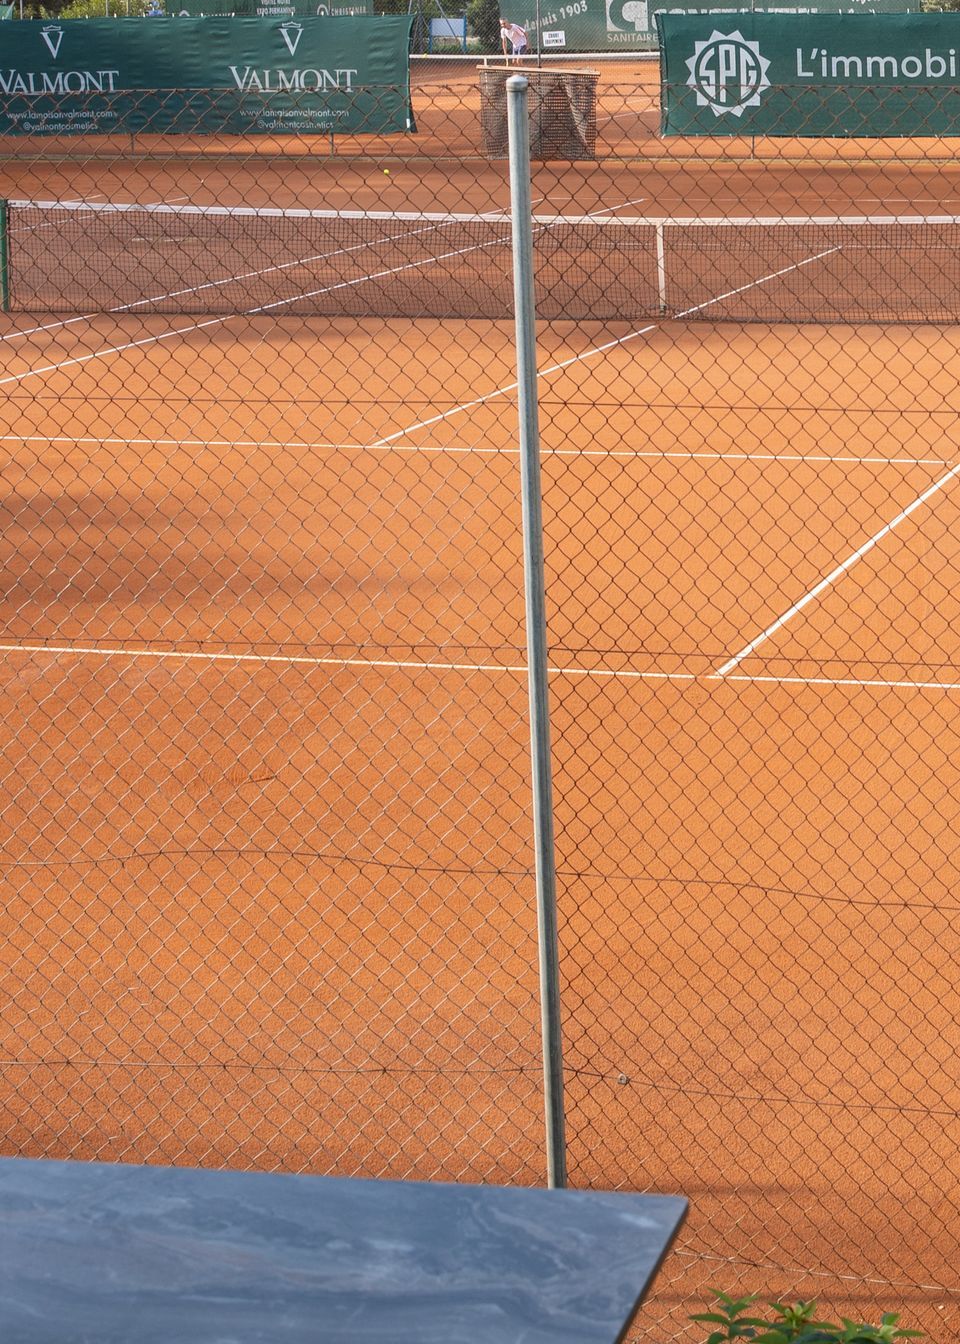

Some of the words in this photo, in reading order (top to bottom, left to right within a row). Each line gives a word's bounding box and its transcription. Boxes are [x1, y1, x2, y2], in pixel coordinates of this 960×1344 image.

[560, 0, 588, 19] 1903
[227, 65, 358, 94] VALMONT
[699, 44, 757, 103] SPG
